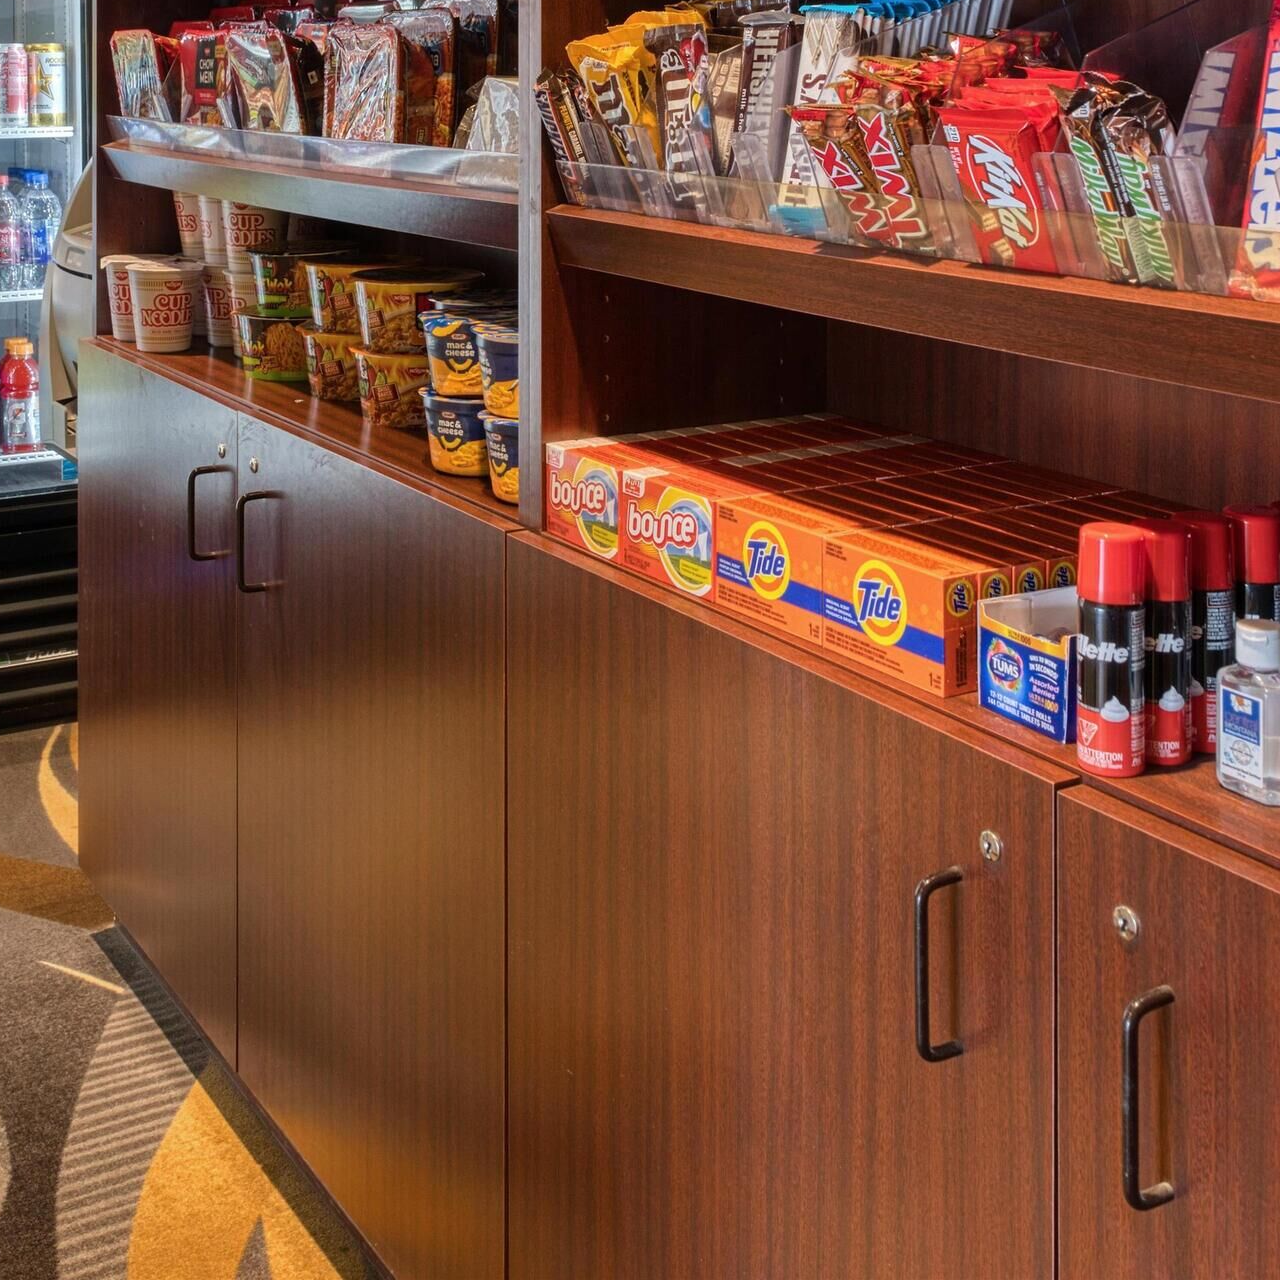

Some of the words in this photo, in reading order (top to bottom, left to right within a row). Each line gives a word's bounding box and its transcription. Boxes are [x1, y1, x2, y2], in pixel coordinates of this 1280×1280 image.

[199, 58, 214, 70] CHOW
[199, 71, 214, 84] MEIN
[858, 112, 927, 238] TWIX
[228, 213, 264, 230] CUP
[155, 294, 192, 312] CUP
[446, 342, 463, 350] mac
[551, 472, 605, 512] bounce
[628, 501, 697, 549] bounce
[747, 539, 786, 579] Tide
[857, 580, 903, 623] Tide
[952, 582, 969, 614] Tide
[991, 655, 1019, 678] TUMS
[1028, 676, 1060, 694] Assorted
[1035, 710, 1052, 724] ROLLS
